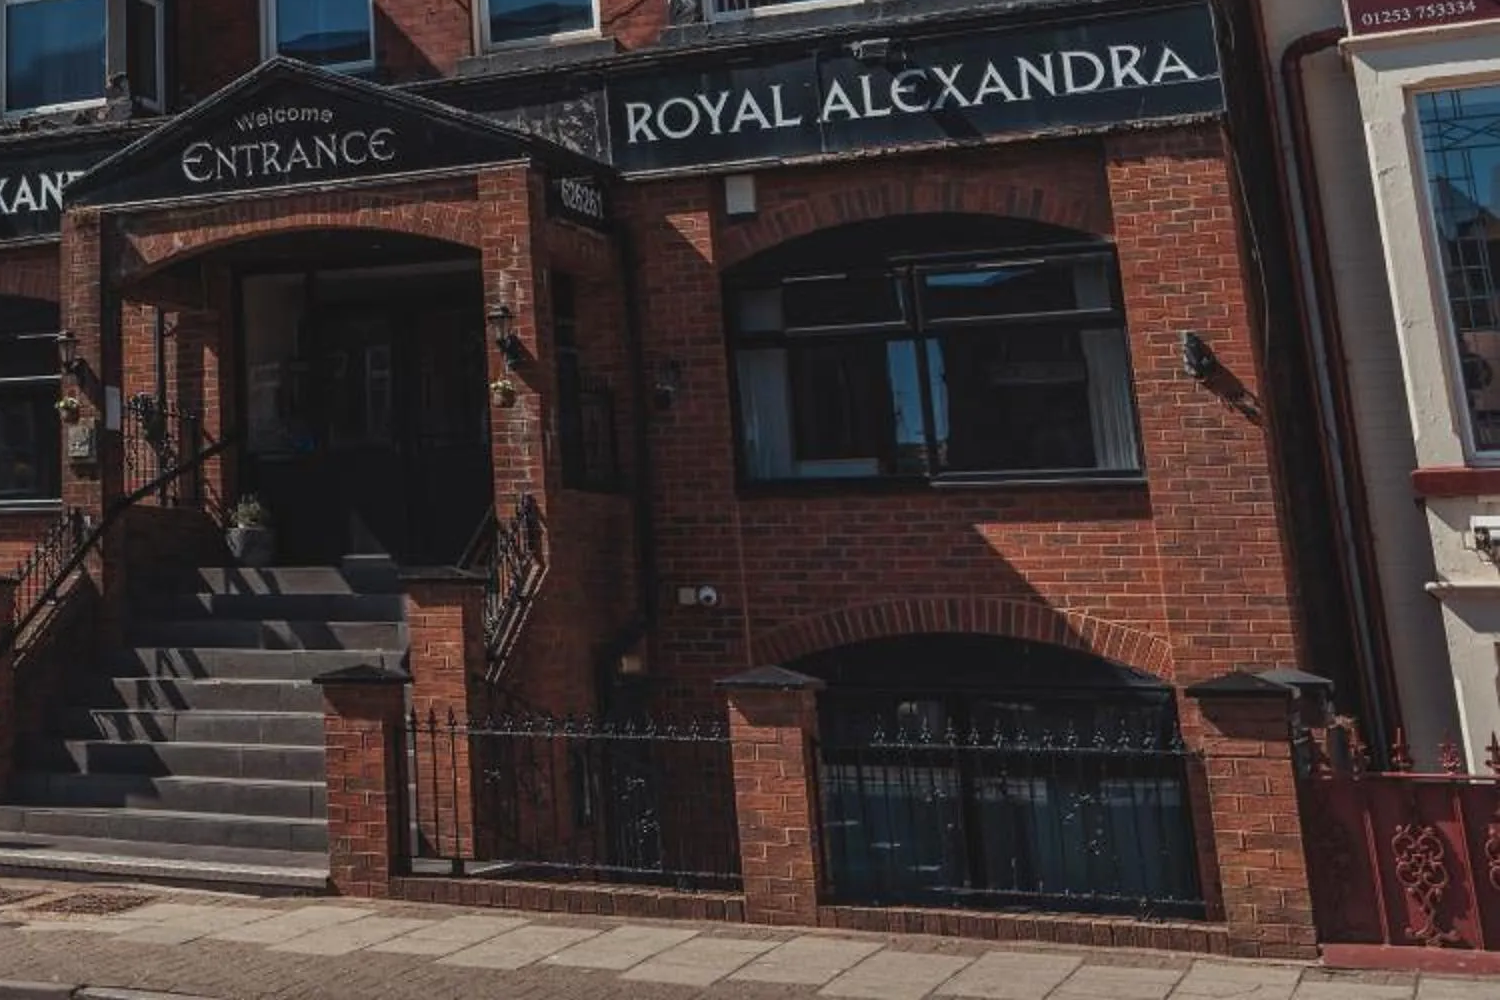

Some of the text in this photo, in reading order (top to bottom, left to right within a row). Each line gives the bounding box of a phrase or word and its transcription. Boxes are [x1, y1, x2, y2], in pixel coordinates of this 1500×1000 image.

[1361, 0, 1477, 26] 01253 753334
[627, 44, 1198, 145] ROYAL ALEXANDRA
[181, 127, 396, 183] ENTRANCE
